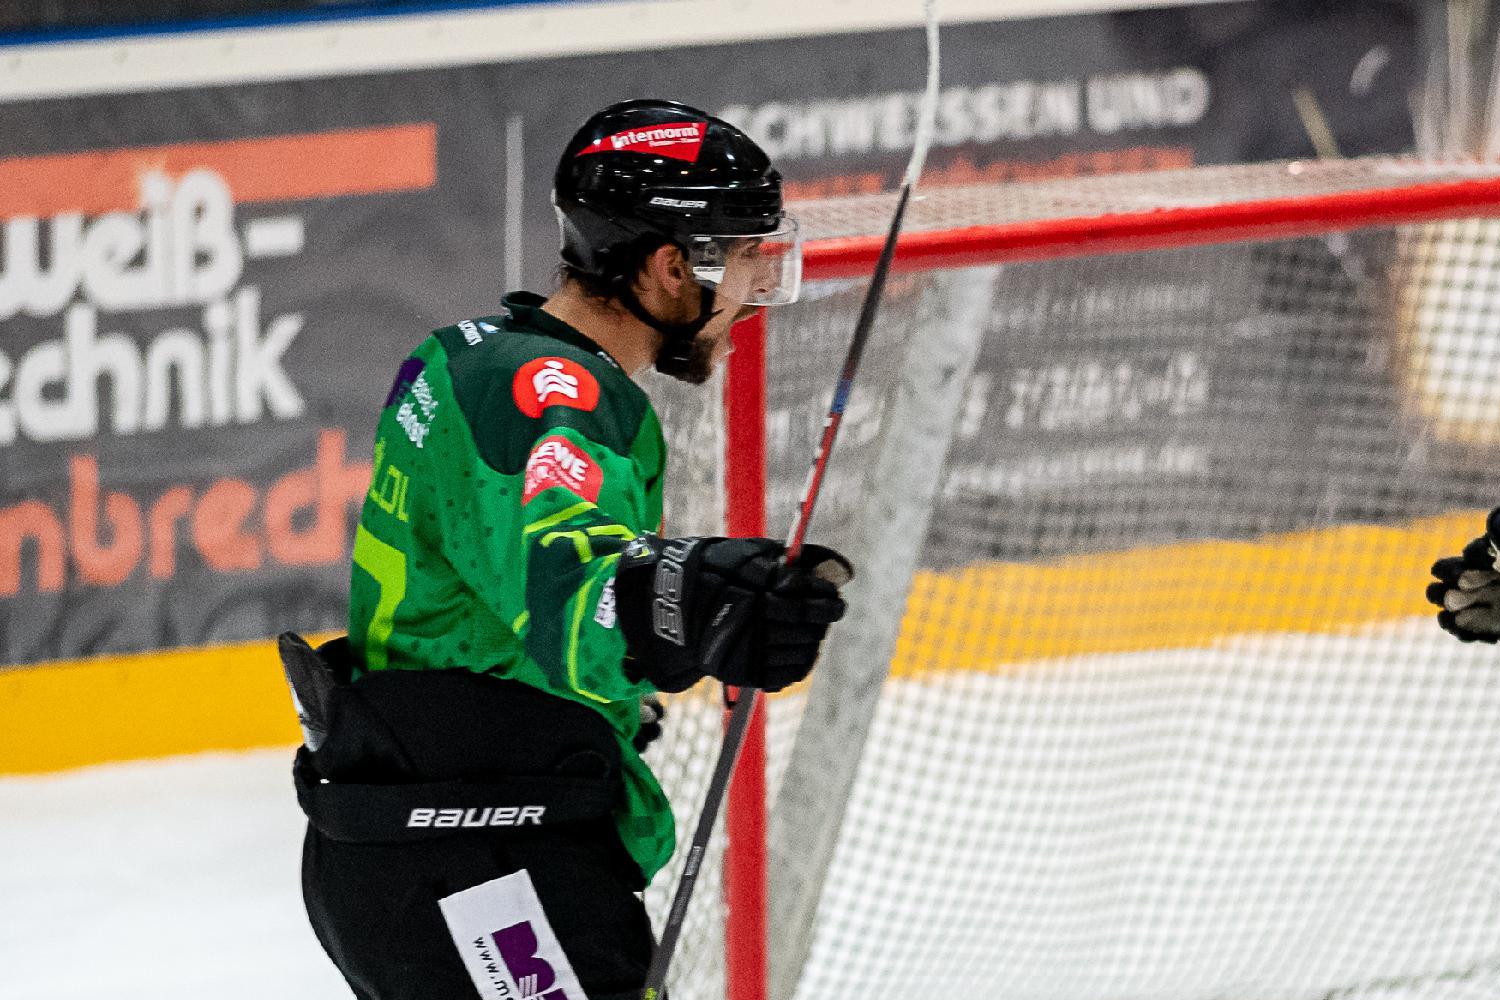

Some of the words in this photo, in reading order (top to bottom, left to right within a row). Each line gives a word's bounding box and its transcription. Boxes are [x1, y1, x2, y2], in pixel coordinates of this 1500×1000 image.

[1087, 67, 1209, 134] UND
[610, 124, 699, 149] Internorm
[649, 196, 708, 209] BAUER
[406, 805, 546, 828] BAUER
